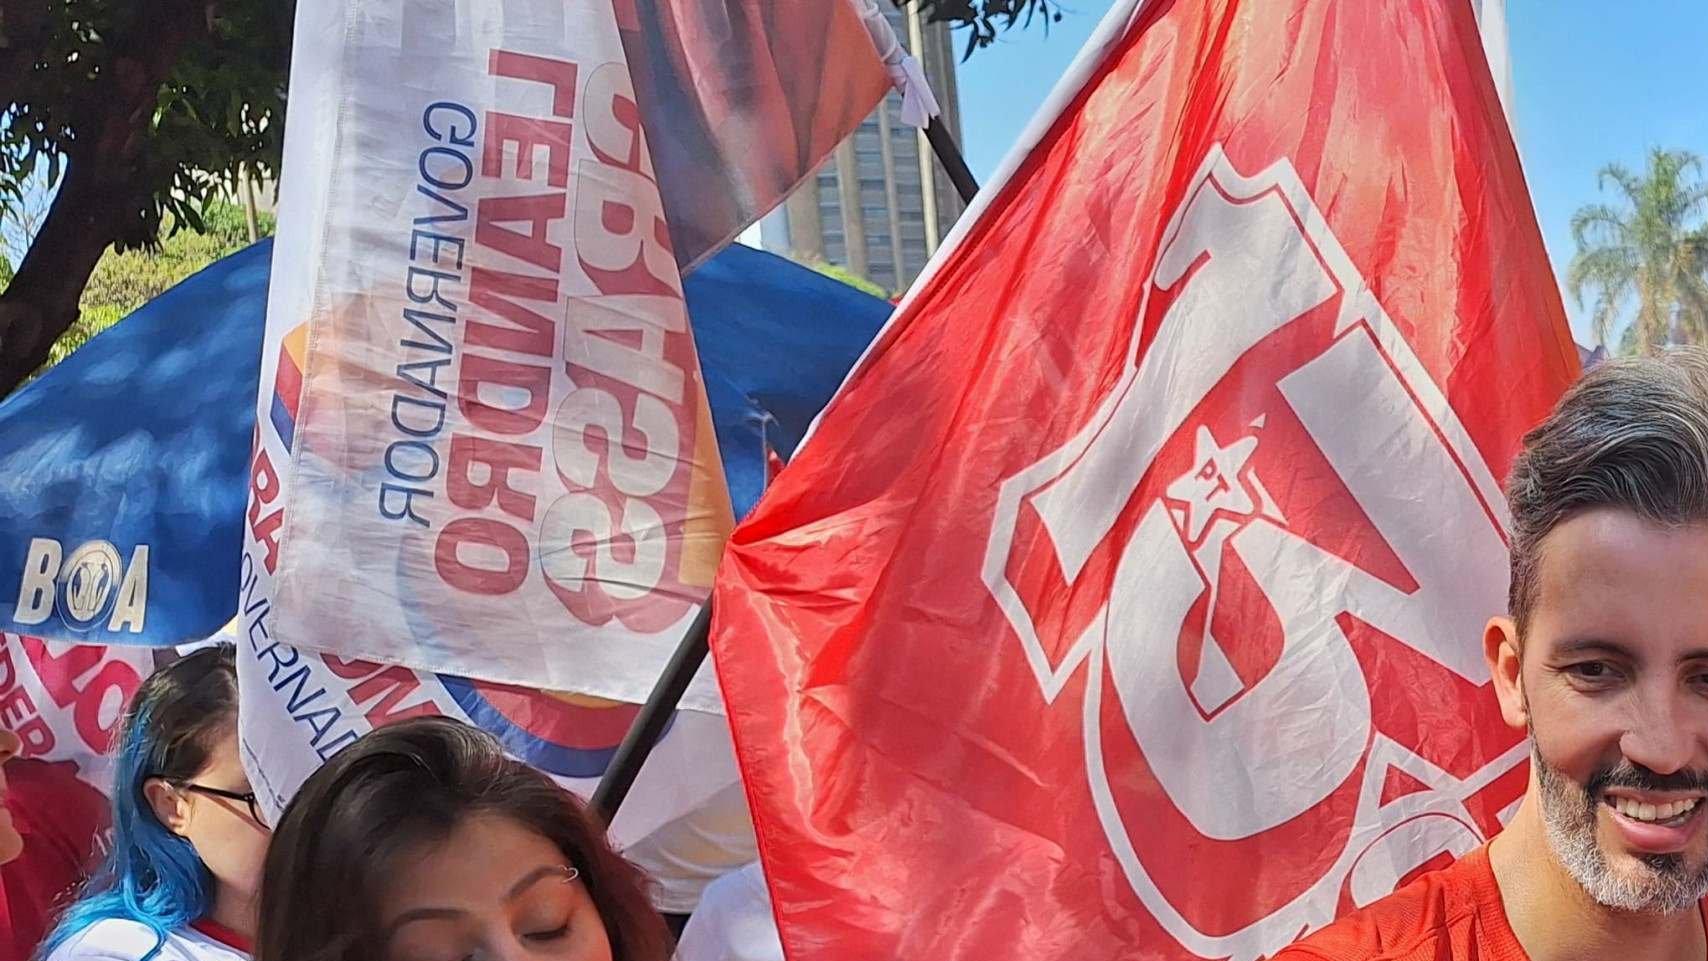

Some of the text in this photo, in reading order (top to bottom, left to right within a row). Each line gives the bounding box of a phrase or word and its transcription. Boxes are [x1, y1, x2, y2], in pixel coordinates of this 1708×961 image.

[1010, 150, 1510, 880] 13
[1195, 458, 1231, 502] PT
[14, 538, 150, 634] BOA
